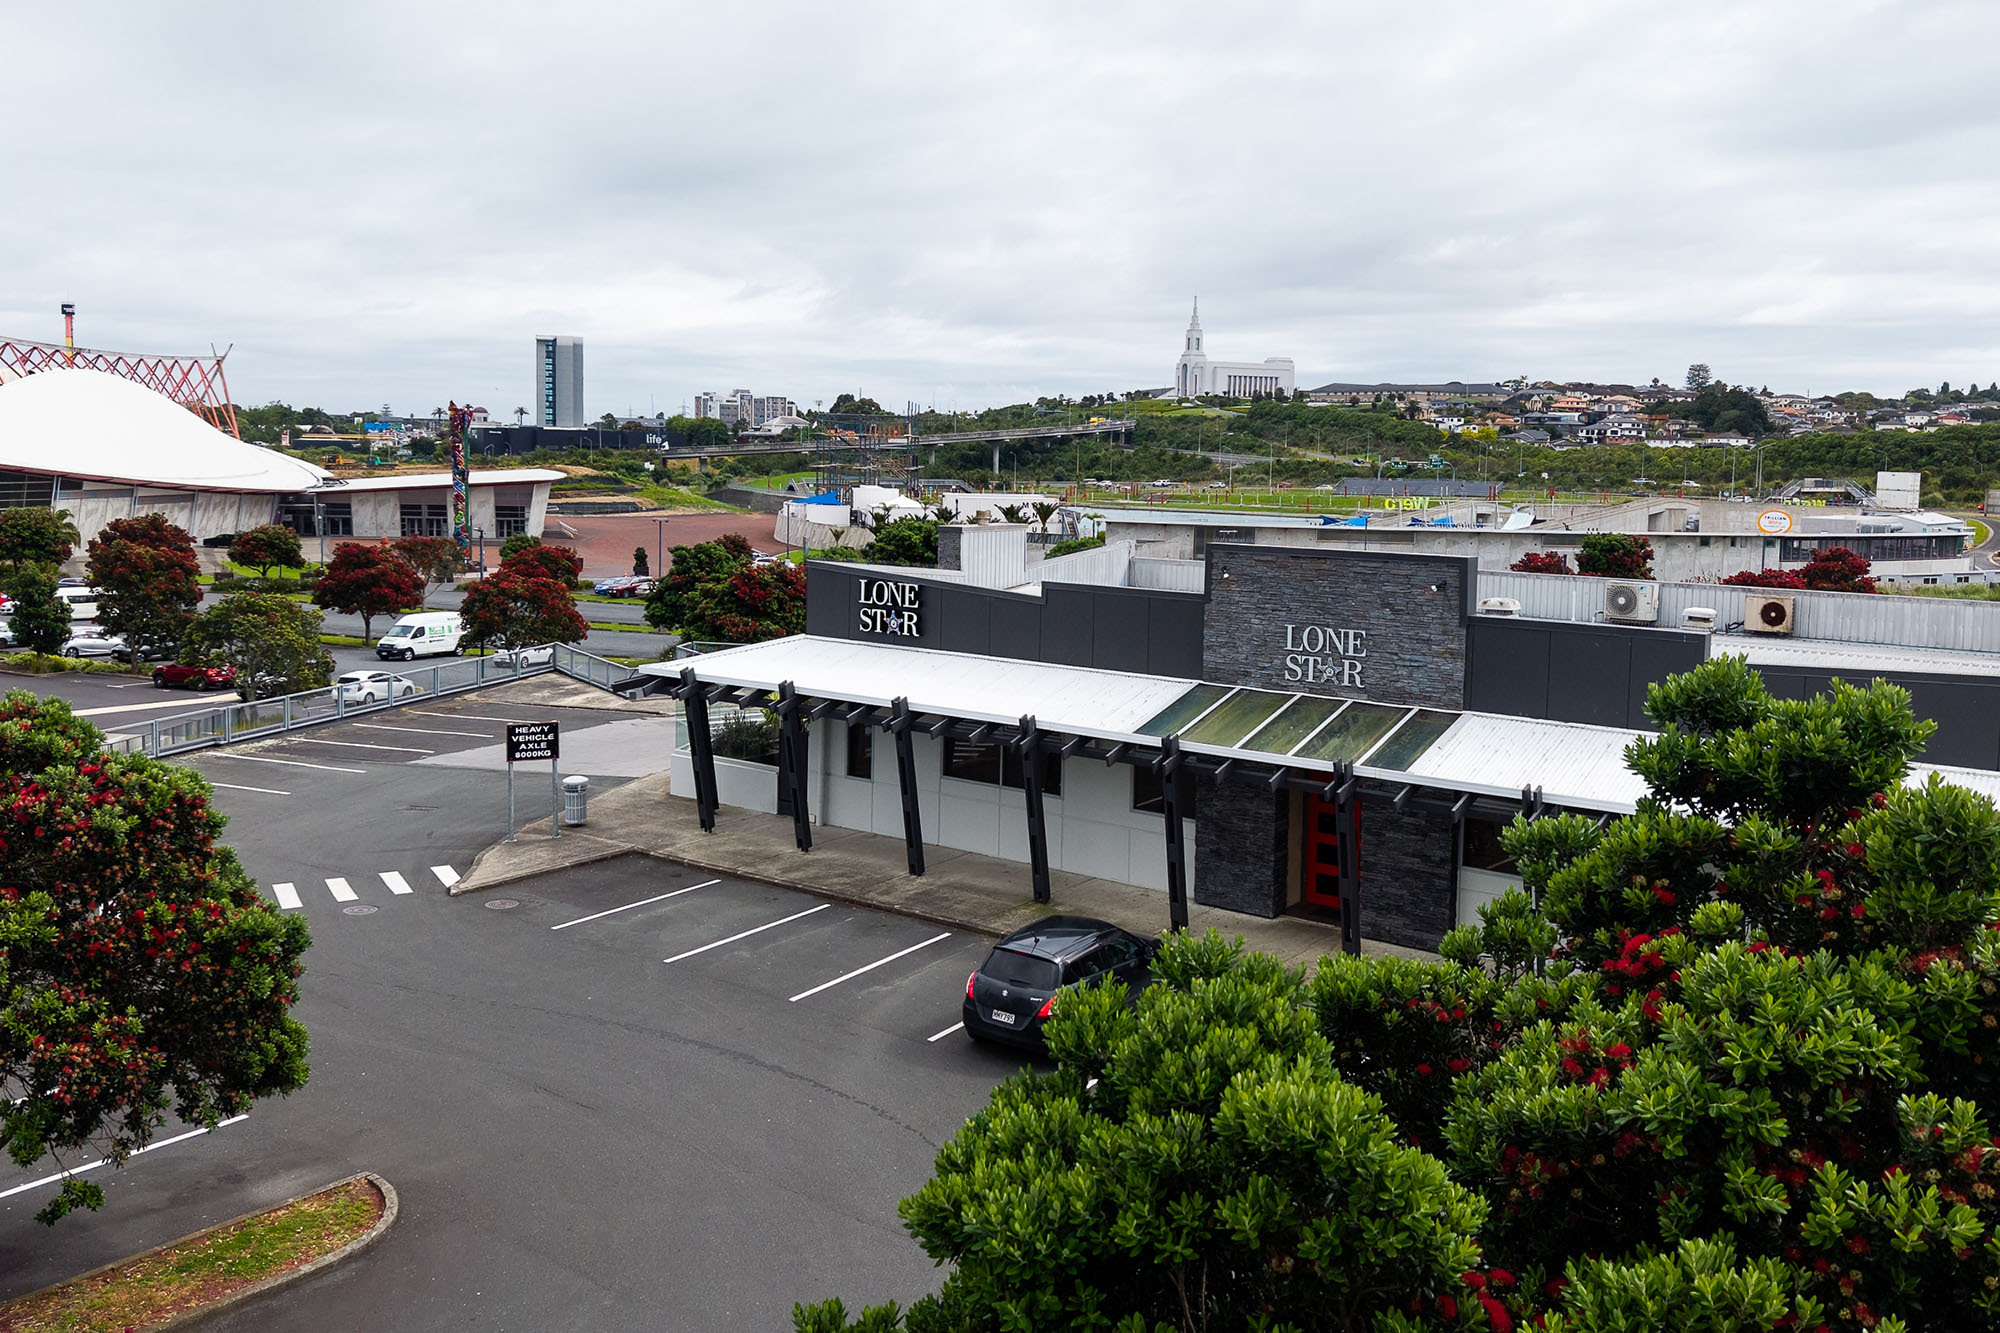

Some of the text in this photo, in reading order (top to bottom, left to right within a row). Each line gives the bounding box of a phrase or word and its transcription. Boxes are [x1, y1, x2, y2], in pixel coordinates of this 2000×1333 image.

[646, 433, 662, 444] life
[858, 579, 919, 608] LONE
[1284, 624, 1366, 657] LONE
[515, 725, 550, 734] HEAVY
[511, 733, 555, 742] VEHICLE
[519, 742, 548, 750] AXLE
[515, 750, 552, 759] 8000KG
